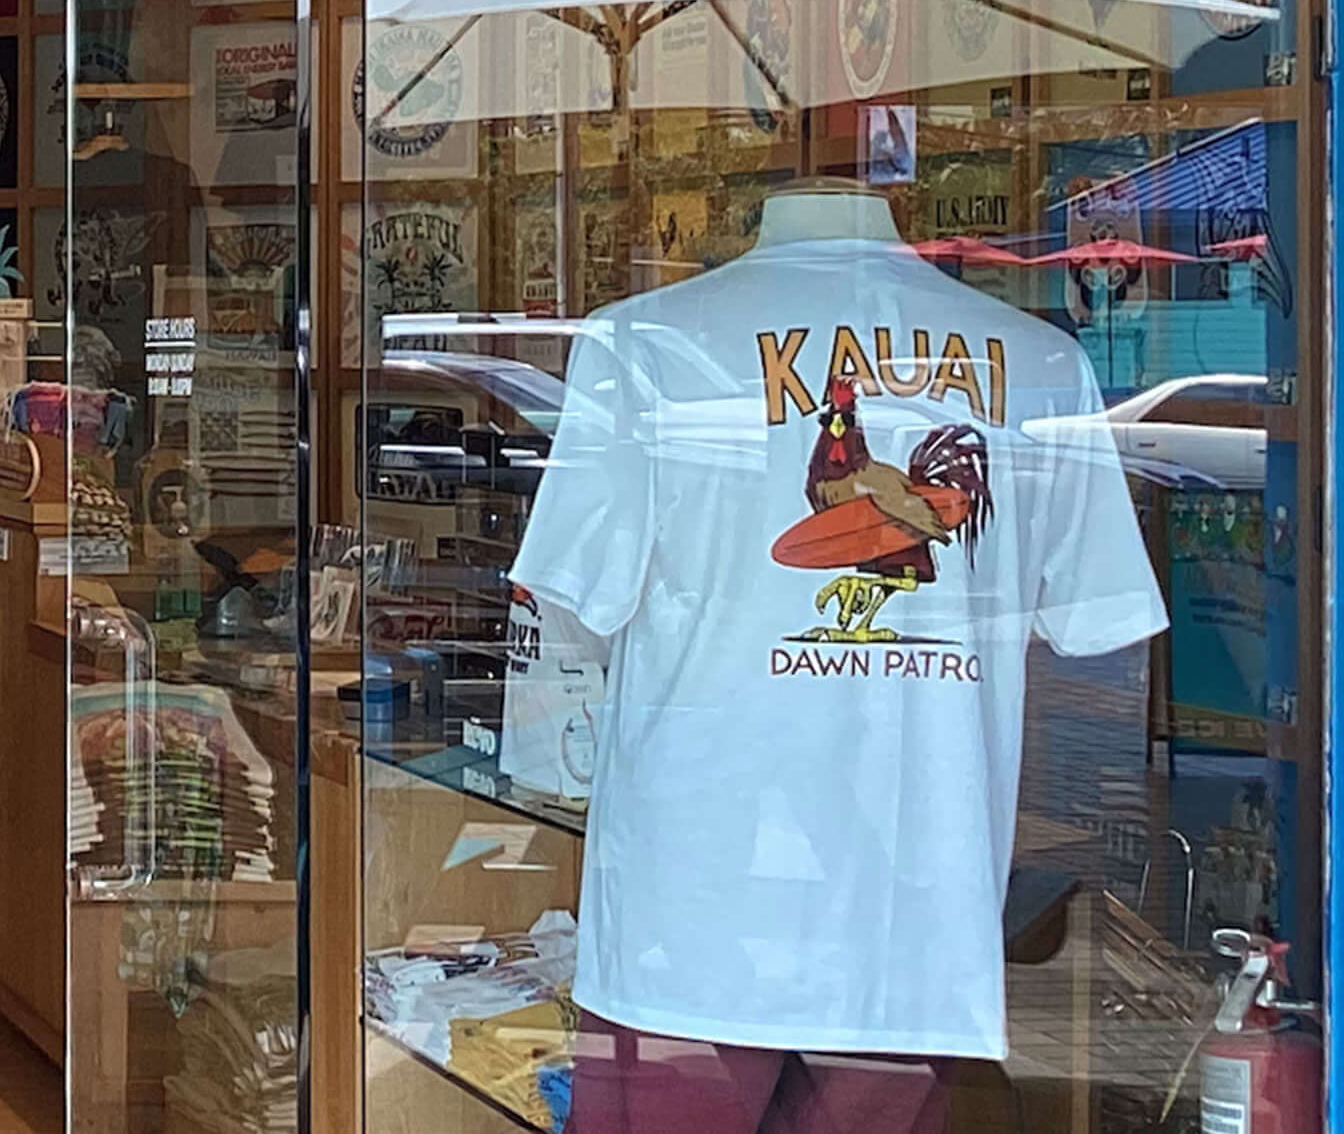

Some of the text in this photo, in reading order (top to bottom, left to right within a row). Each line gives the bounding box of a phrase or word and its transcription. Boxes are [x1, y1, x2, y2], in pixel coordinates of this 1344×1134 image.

[756, 325, 1007, 429] KAUAI
[770, 648, 984, 683] DAWN PATRO
